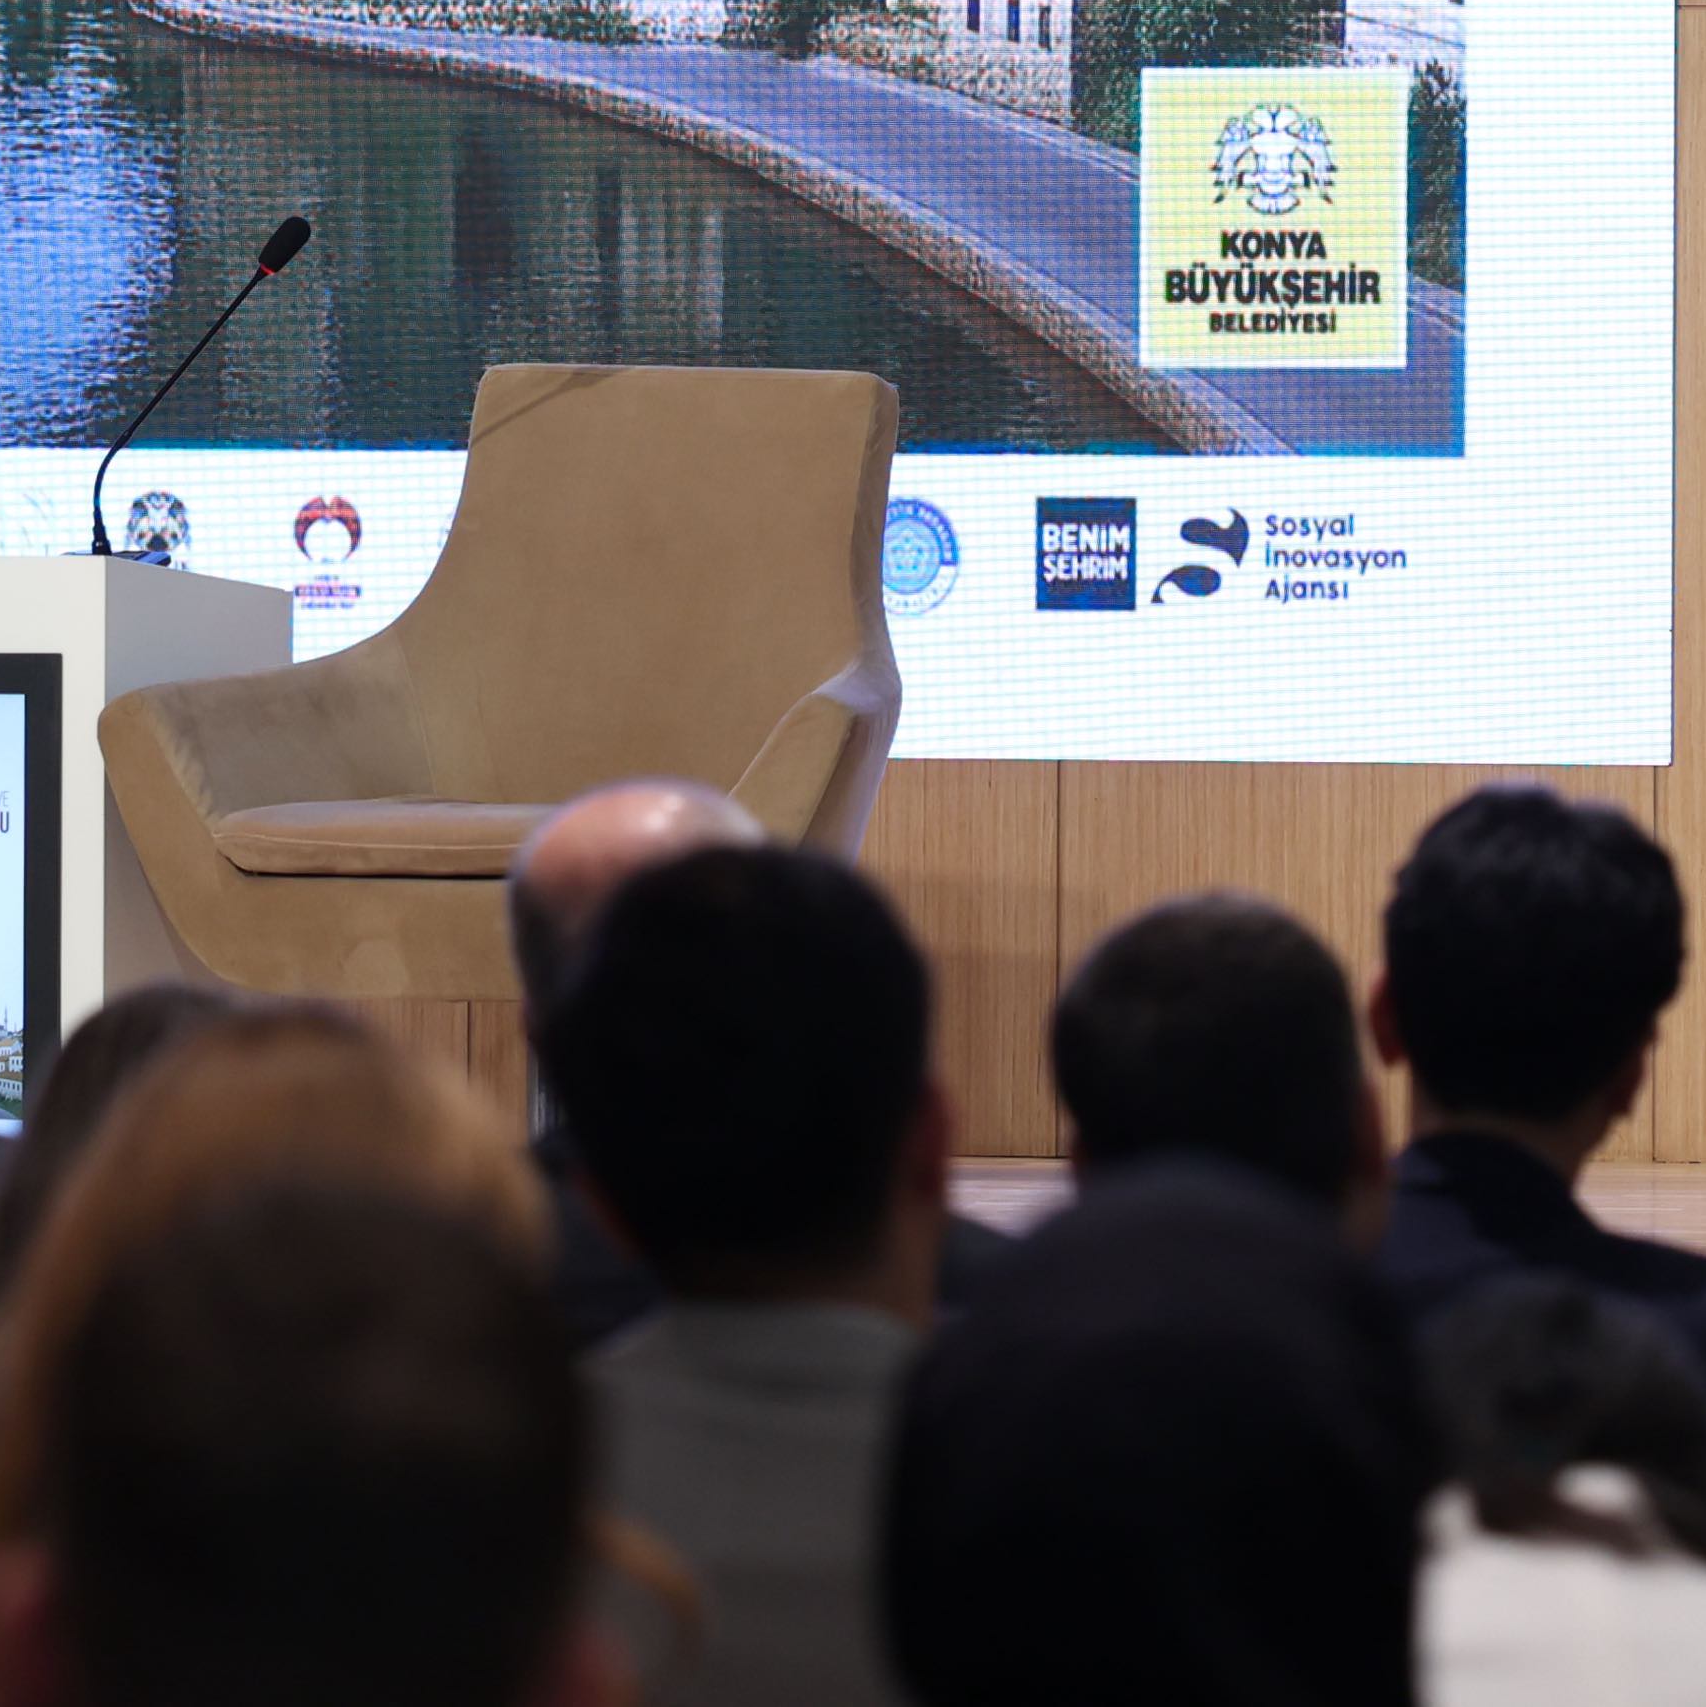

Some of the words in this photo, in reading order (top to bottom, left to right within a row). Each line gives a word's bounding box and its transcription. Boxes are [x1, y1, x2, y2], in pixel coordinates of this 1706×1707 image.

[1220, 229, 1327, 260] KONYA
[1165, 261, 1382, 309] BÜYÜKŞEHİR
[1209, 307, 1337, 334] BELEDİYESİ
[1042, 522, 1131, 554] BENİM
[1265, 513, 1355, 542] Sosyal
[1042, 553, 1129, 583] ŞEHRİM
[1265, 541, 1407, 576] İnovasyon
[1265, 573, 1349, 605] Ajansı
